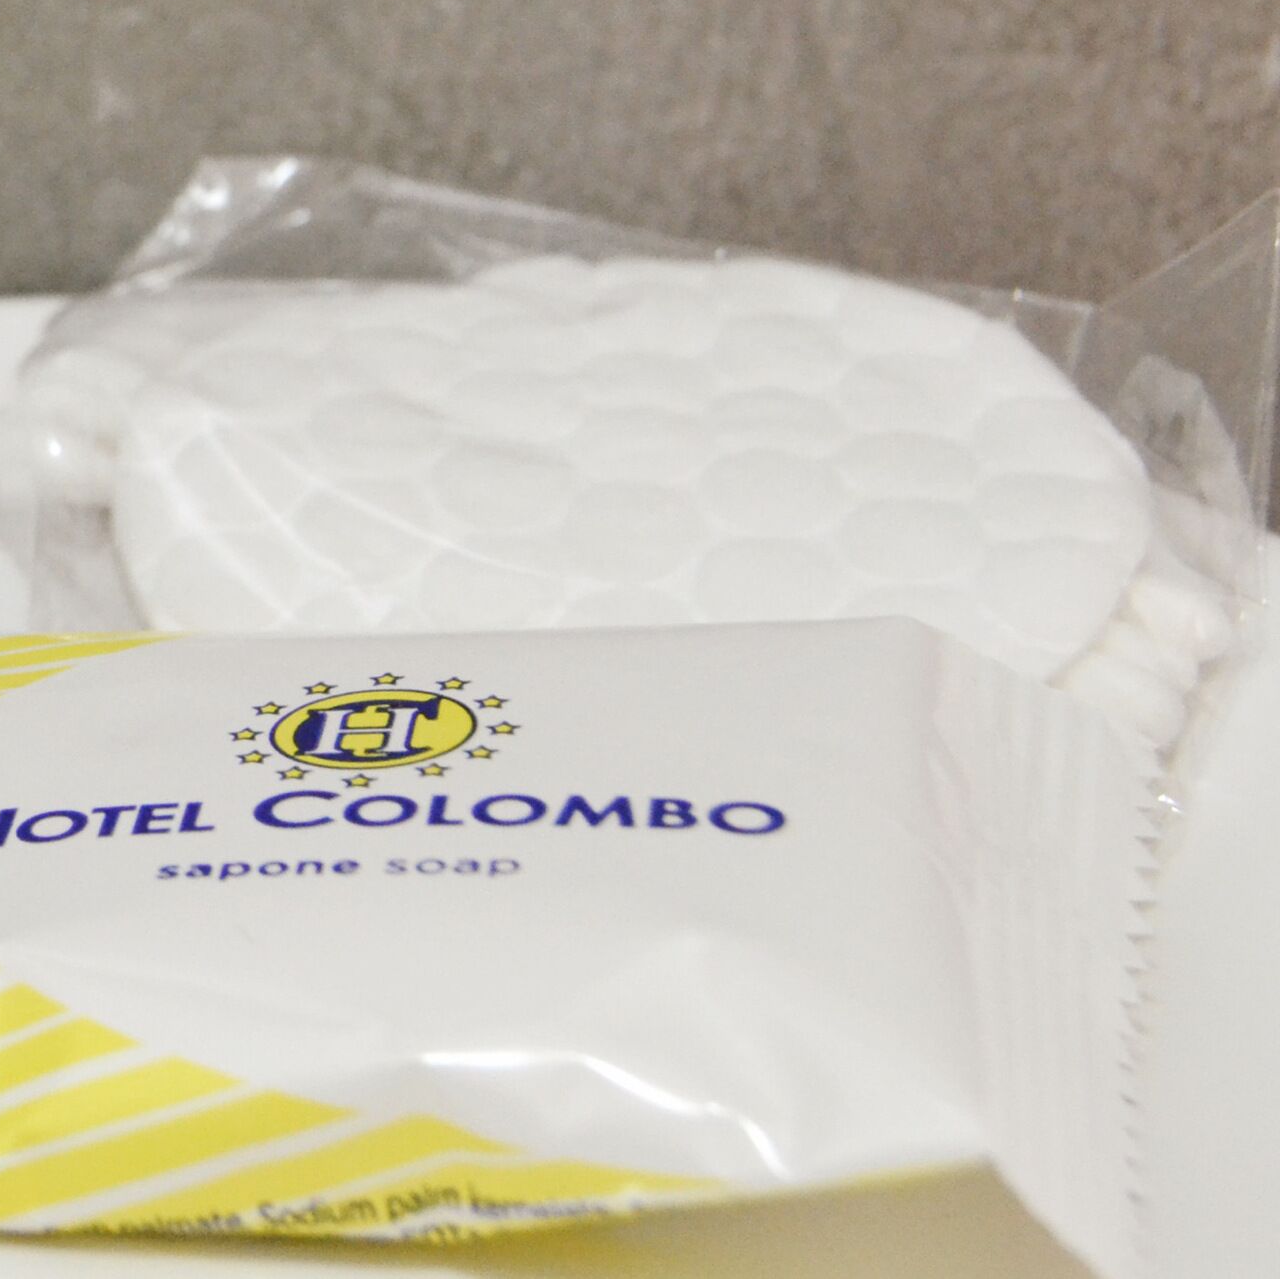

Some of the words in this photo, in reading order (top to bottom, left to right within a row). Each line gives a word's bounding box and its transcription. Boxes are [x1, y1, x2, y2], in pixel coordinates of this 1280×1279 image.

[252, 789, 787, 836] COLOMBO
[156, 859, 361, 882] sapone
[384, 854, 522, 880] soap
